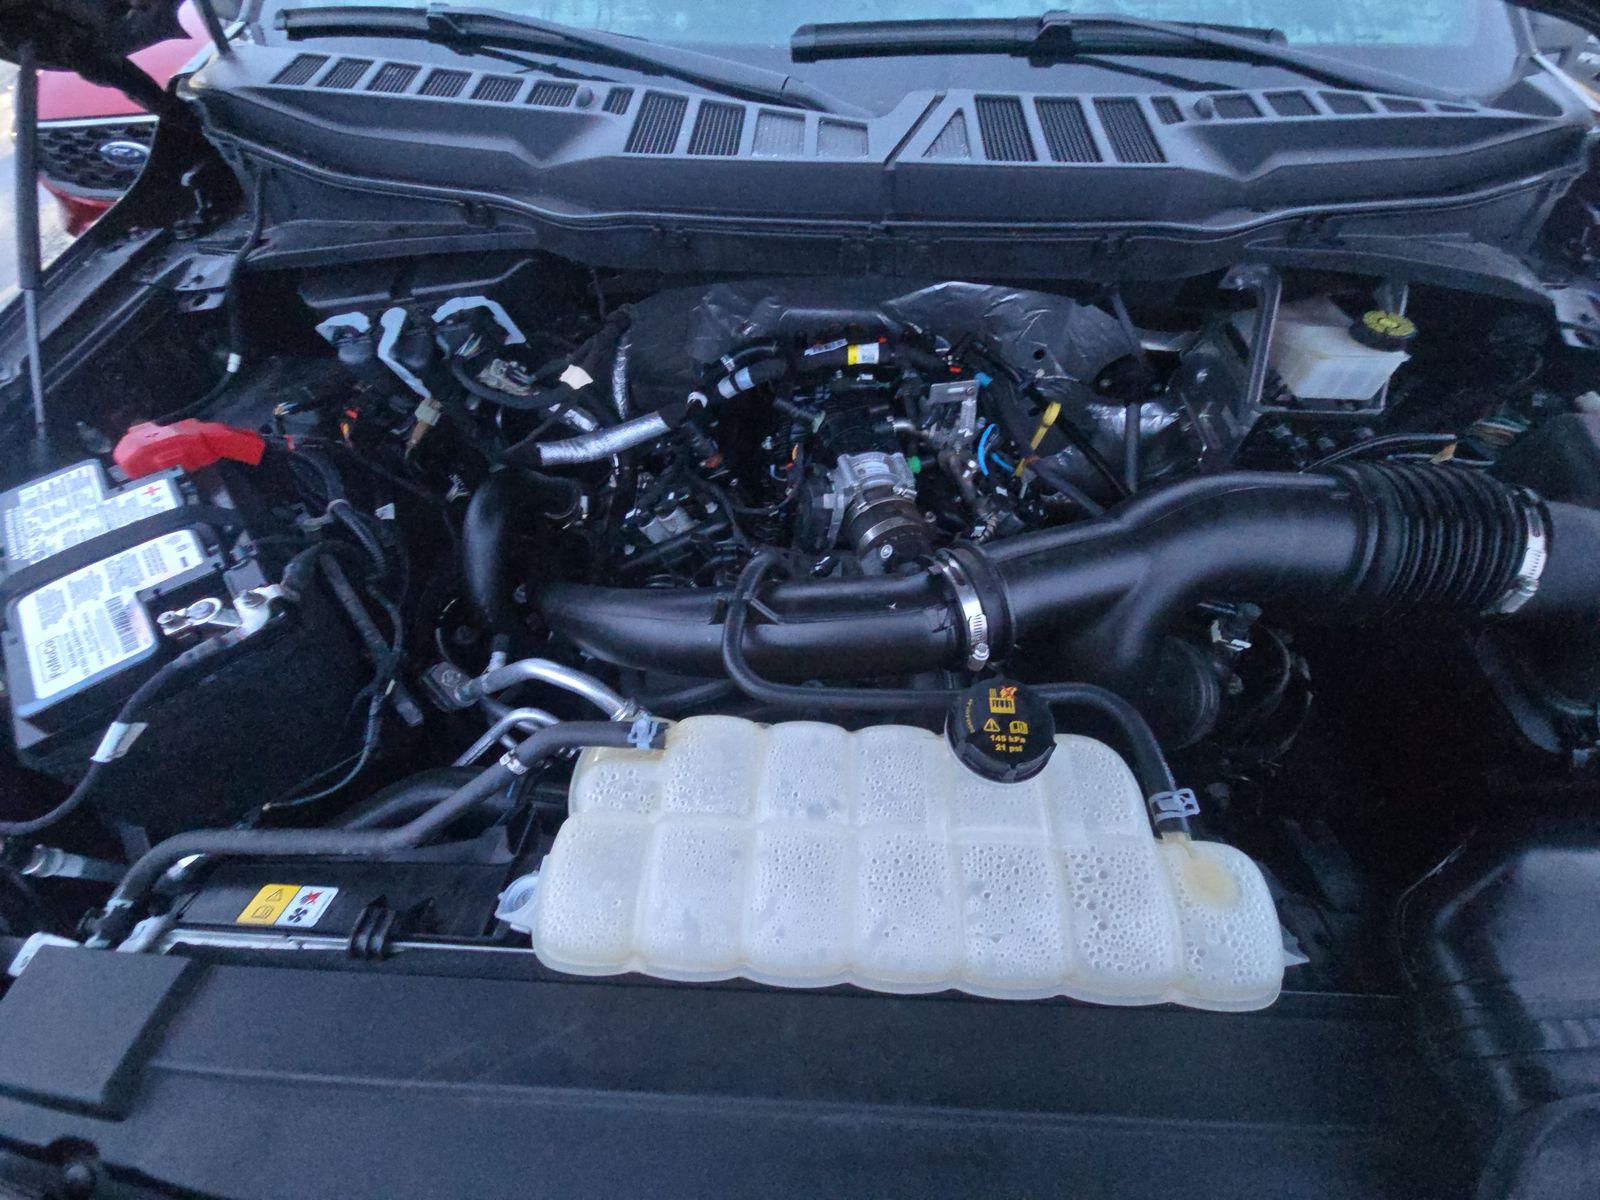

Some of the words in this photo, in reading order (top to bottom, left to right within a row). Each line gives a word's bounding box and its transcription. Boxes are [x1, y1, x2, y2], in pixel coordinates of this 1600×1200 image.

[44, 640, 63, 679] FoMoCo
[990, 734, 1007, 742] 145
[1008, 735, 1026, 743] kPa
[995, 743, 1006, 751] 21
[1009, 745, 1023, 753] psi
